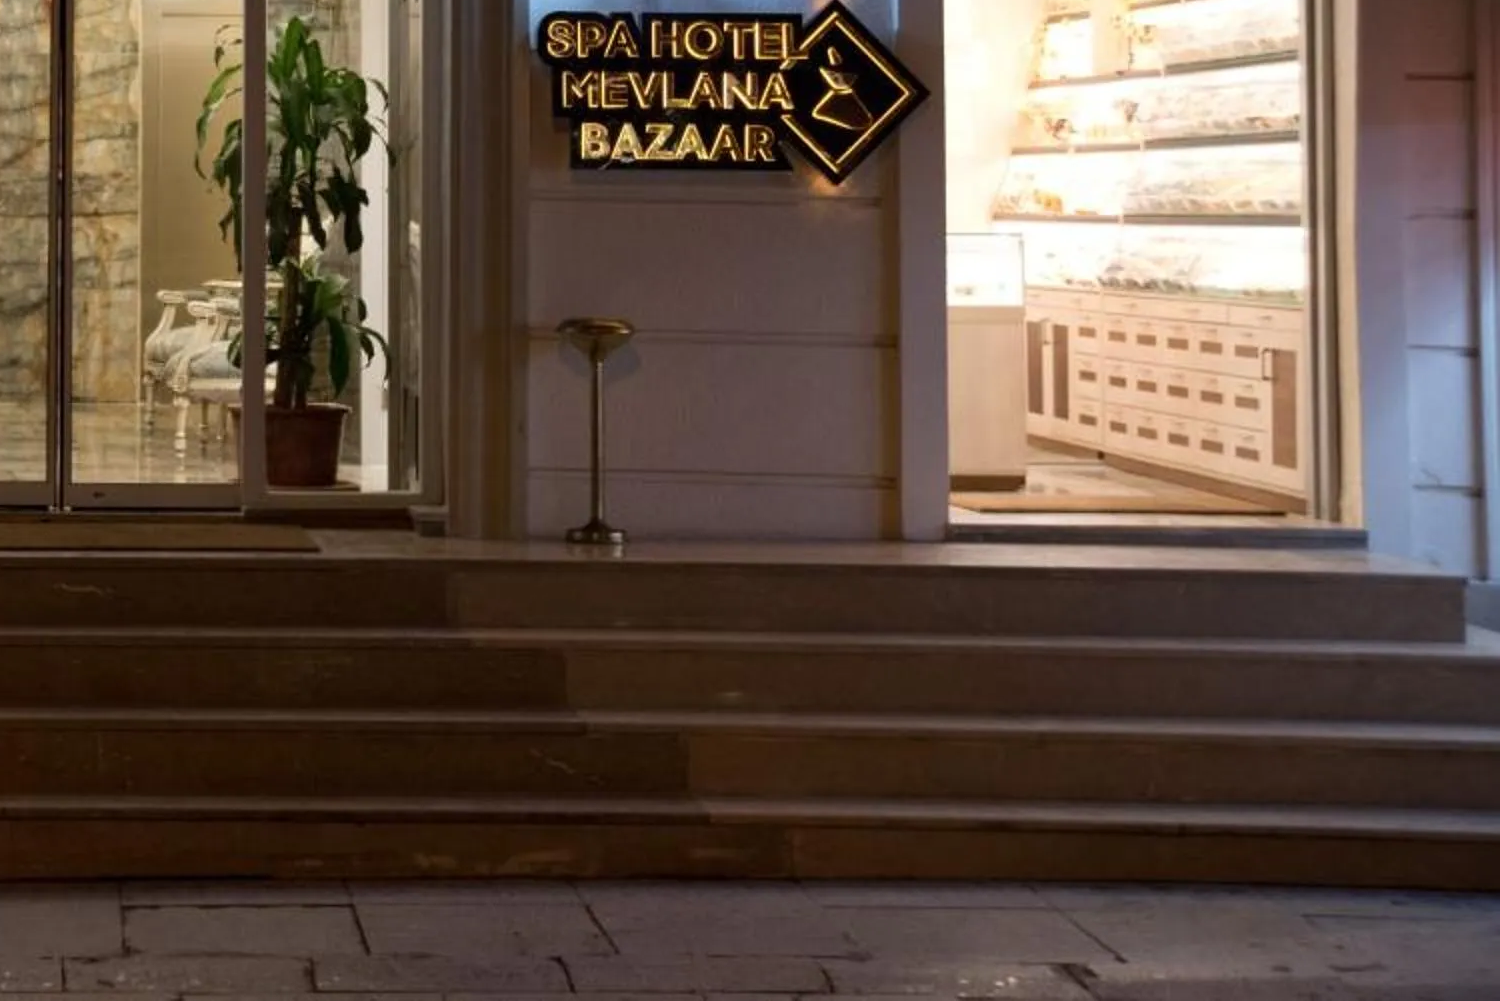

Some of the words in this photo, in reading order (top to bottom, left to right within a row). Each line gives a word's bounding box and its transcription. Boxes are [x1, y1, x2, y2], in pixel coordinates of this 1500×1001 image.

[547, 20, 638, 59] SPA
[651, 21, 809, 61] HOTEL
[562, 72, 795, 110] MEVLANA
[581, 122, 777, 162] BAZAAR
